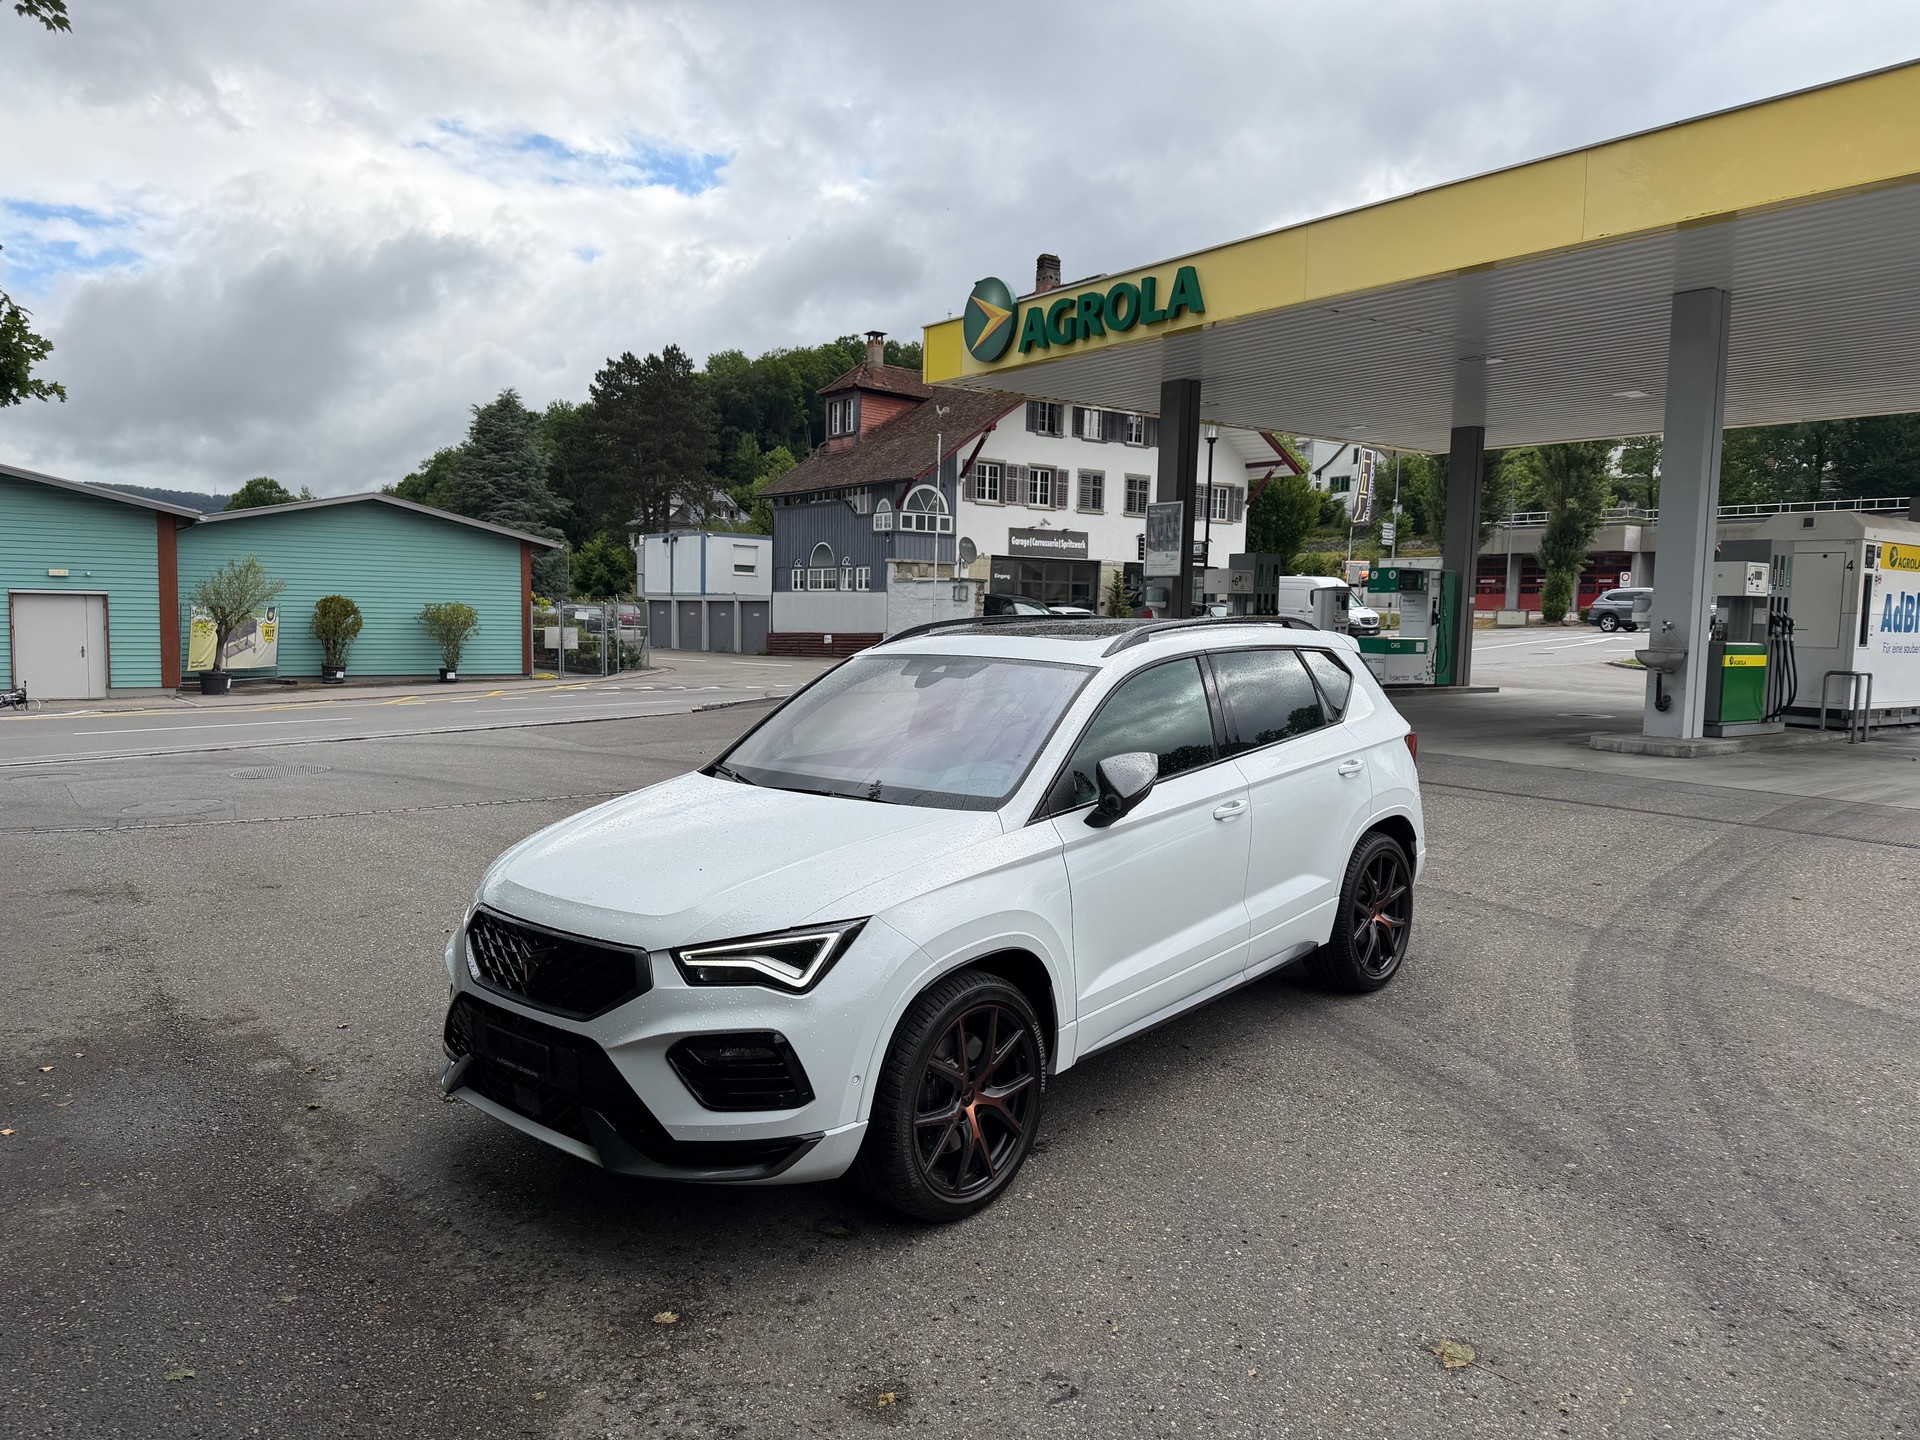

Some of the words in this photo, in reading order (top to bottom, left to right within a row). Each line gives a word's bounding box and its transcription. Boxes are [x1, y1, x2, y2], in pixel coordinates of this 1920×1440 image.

[1018, 265, 1205, 353] AGROLA
[1011, 536, 1029, 547] Garage
[1032, 537, 1059, 548] Carrosserie
[1846, 559, 1855, 572] 4
[1234, 577, 1239, 586] 6
[1750, 573, 1755, 585] 2
[1880, 591, 1920, 634] AdBl
[1882, 641, 1892, 654] Für
[1892, 642, 1903, 654] eine
[1032, 1021, 1047, 1093] BRIDGESTONE
